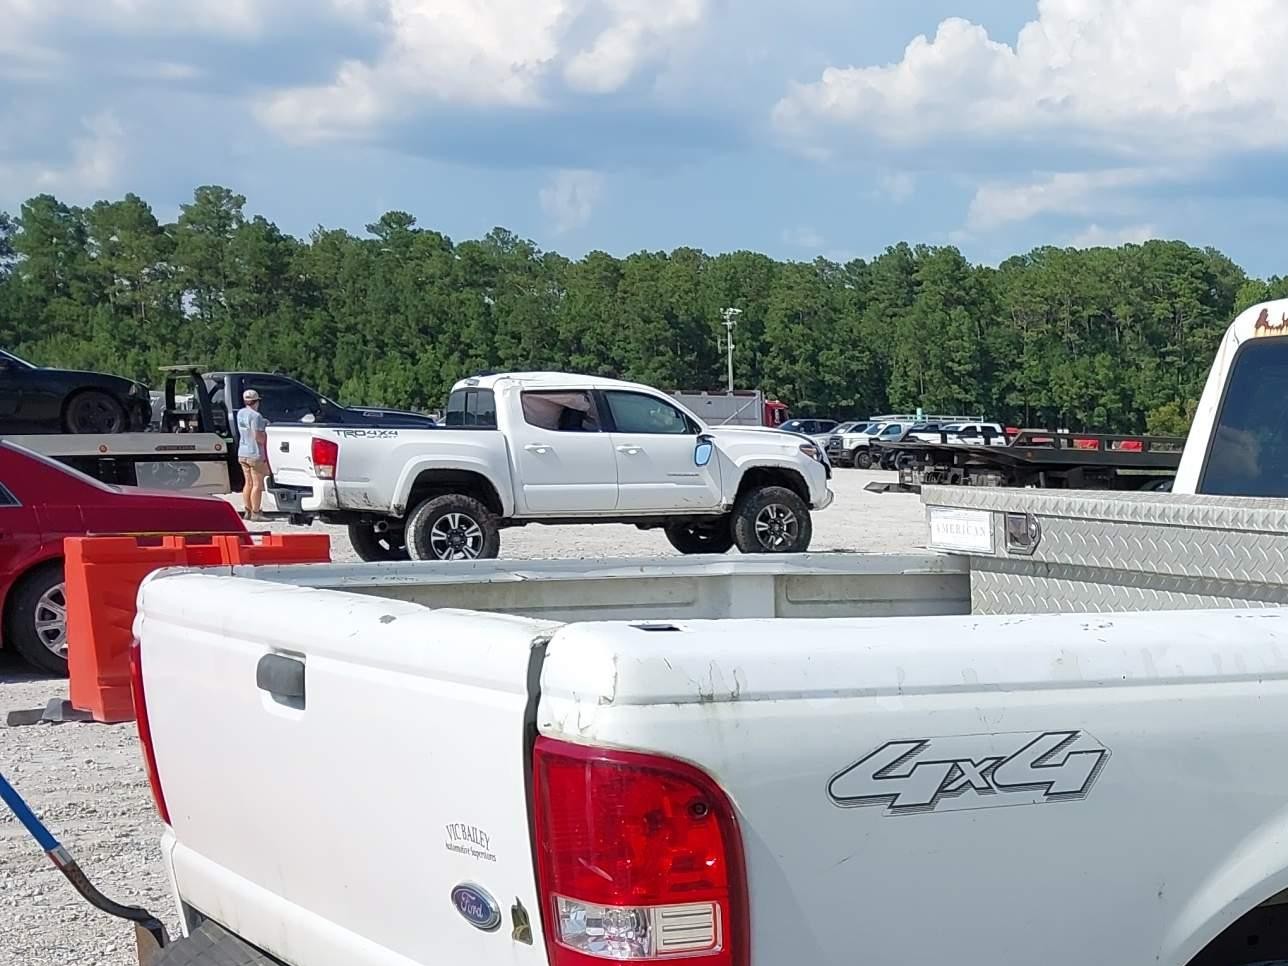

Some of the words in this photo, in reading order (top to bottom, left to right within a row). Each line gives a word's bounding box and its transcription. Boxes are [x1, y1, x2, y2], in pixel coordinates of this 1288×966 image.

[828, 730, 1109, 814] 4x4
[446, 823, 462, 841] VIC
[460, 823, 490, 851] BAILEY
[460, 891, 484, 919] Ford
